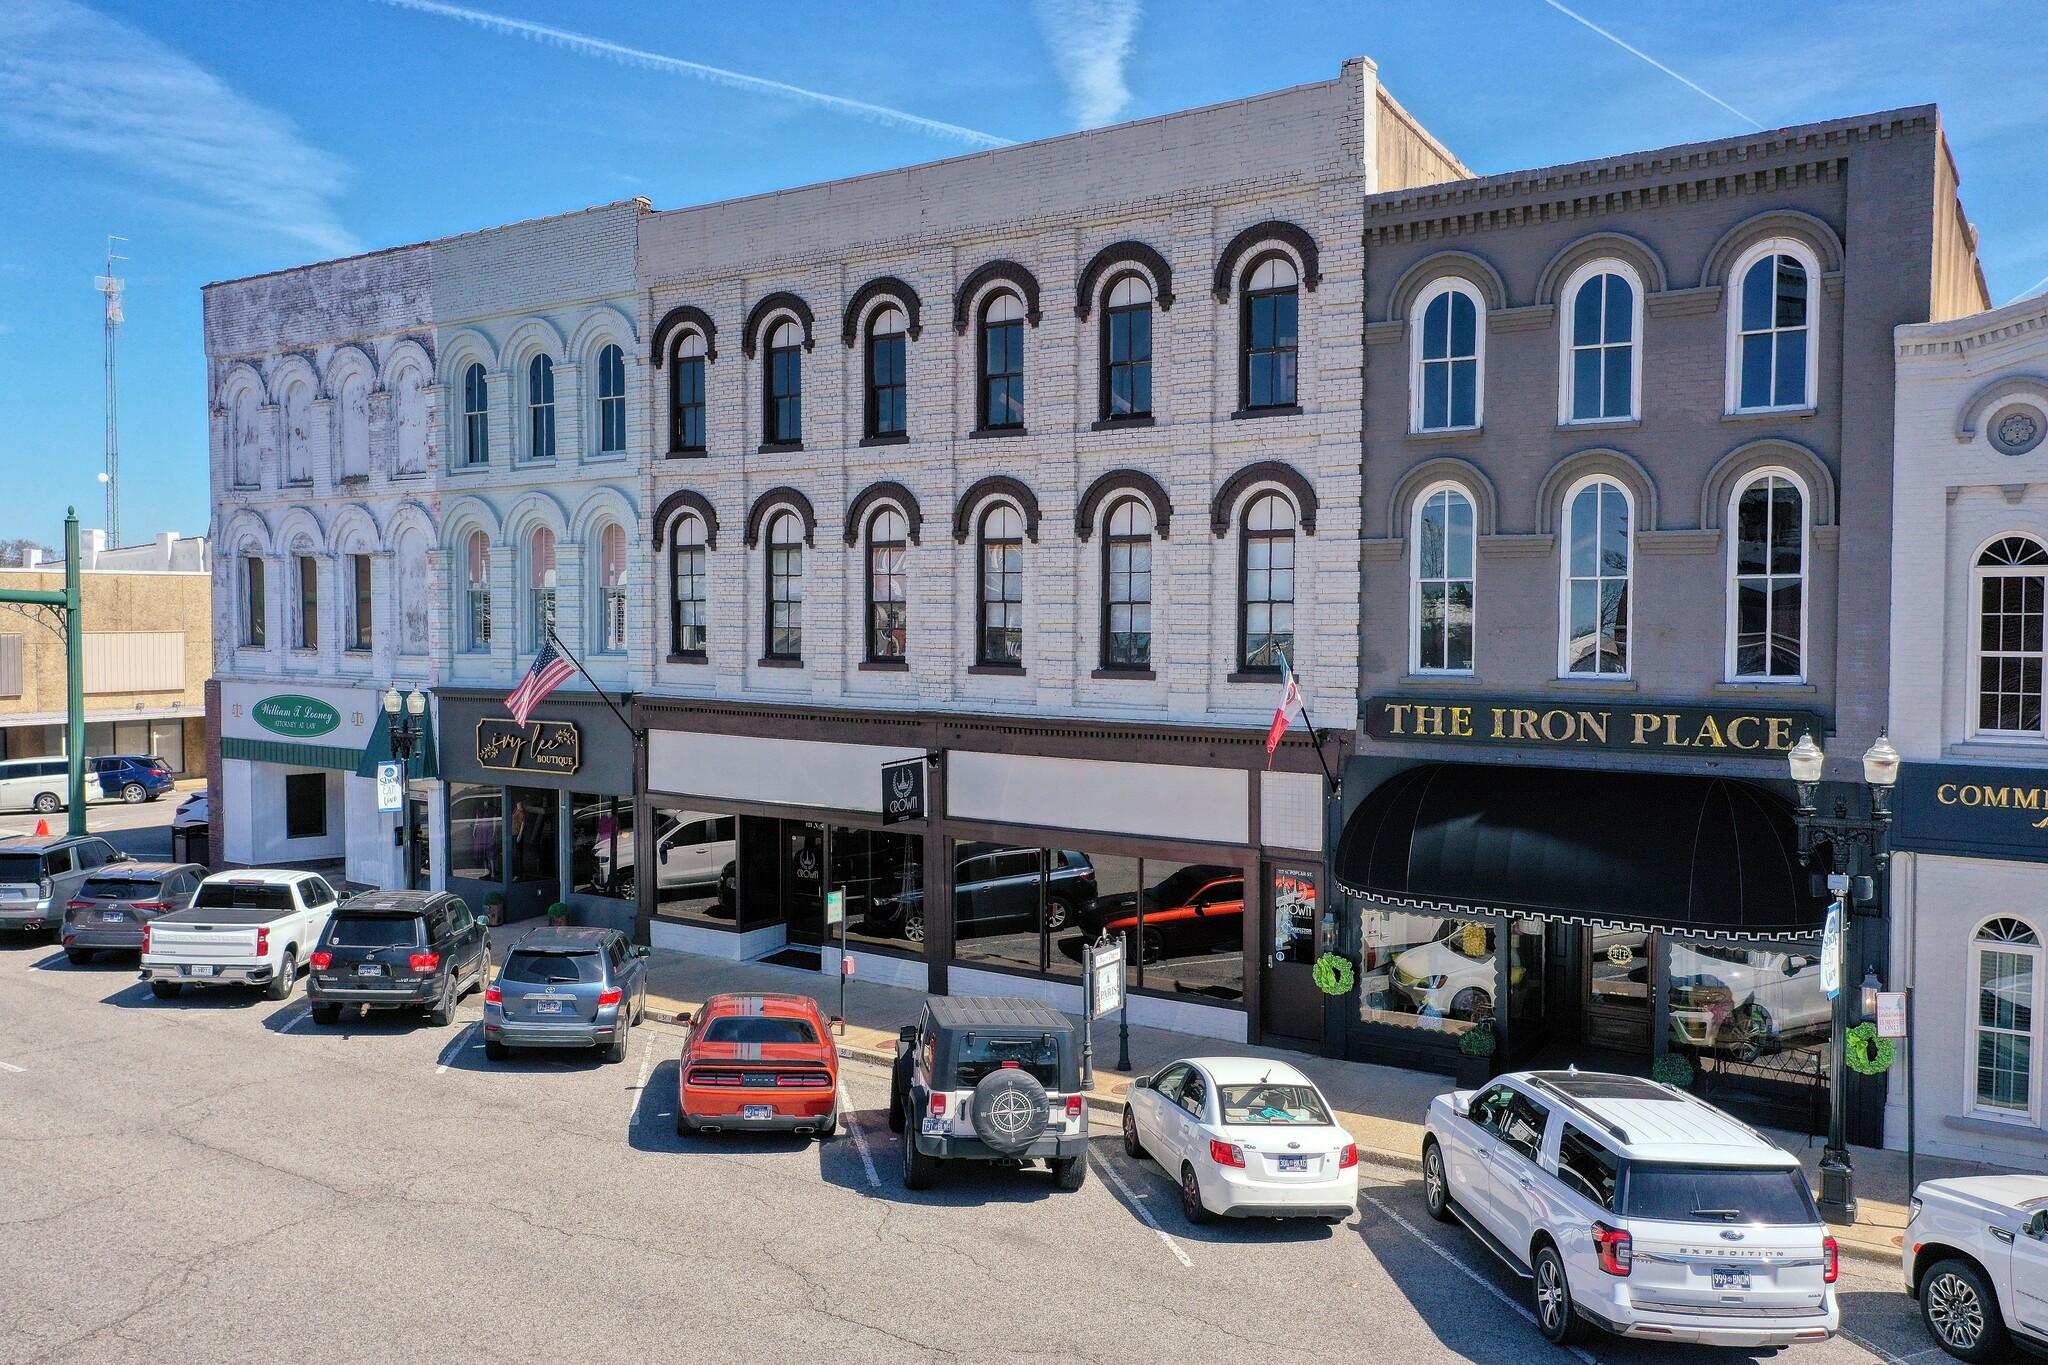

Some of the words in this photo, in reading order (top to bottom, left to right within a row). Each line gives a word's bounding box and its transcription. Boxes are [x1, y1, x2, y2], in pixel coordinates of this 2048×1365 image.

[261, 703, 291, 717] William
[304, 706, 333, 725] Looney
[275, 720, 297, 729] ATTORNEY
[306, 722, 317, 730] LAW
[1385, 703, 1473, 737] THE
[1490, 708, 1612, 744] IRON
[1631, 712, 1795, 752] PLACE
[530, 723, 559, 759] lee
[537, 755, 573, 767] BOUTIQUE
[890, 796, 918, 814] CROWN
[796, 868, 819, 880] CROWN
[1279, 904, 1312, 917] CROWN
[1100, 985, 1117, 1000] PARIS
[1680, 1248, 1785, 1257] EXPEDITION
[1714, 1273, 1727, 1284] 999
